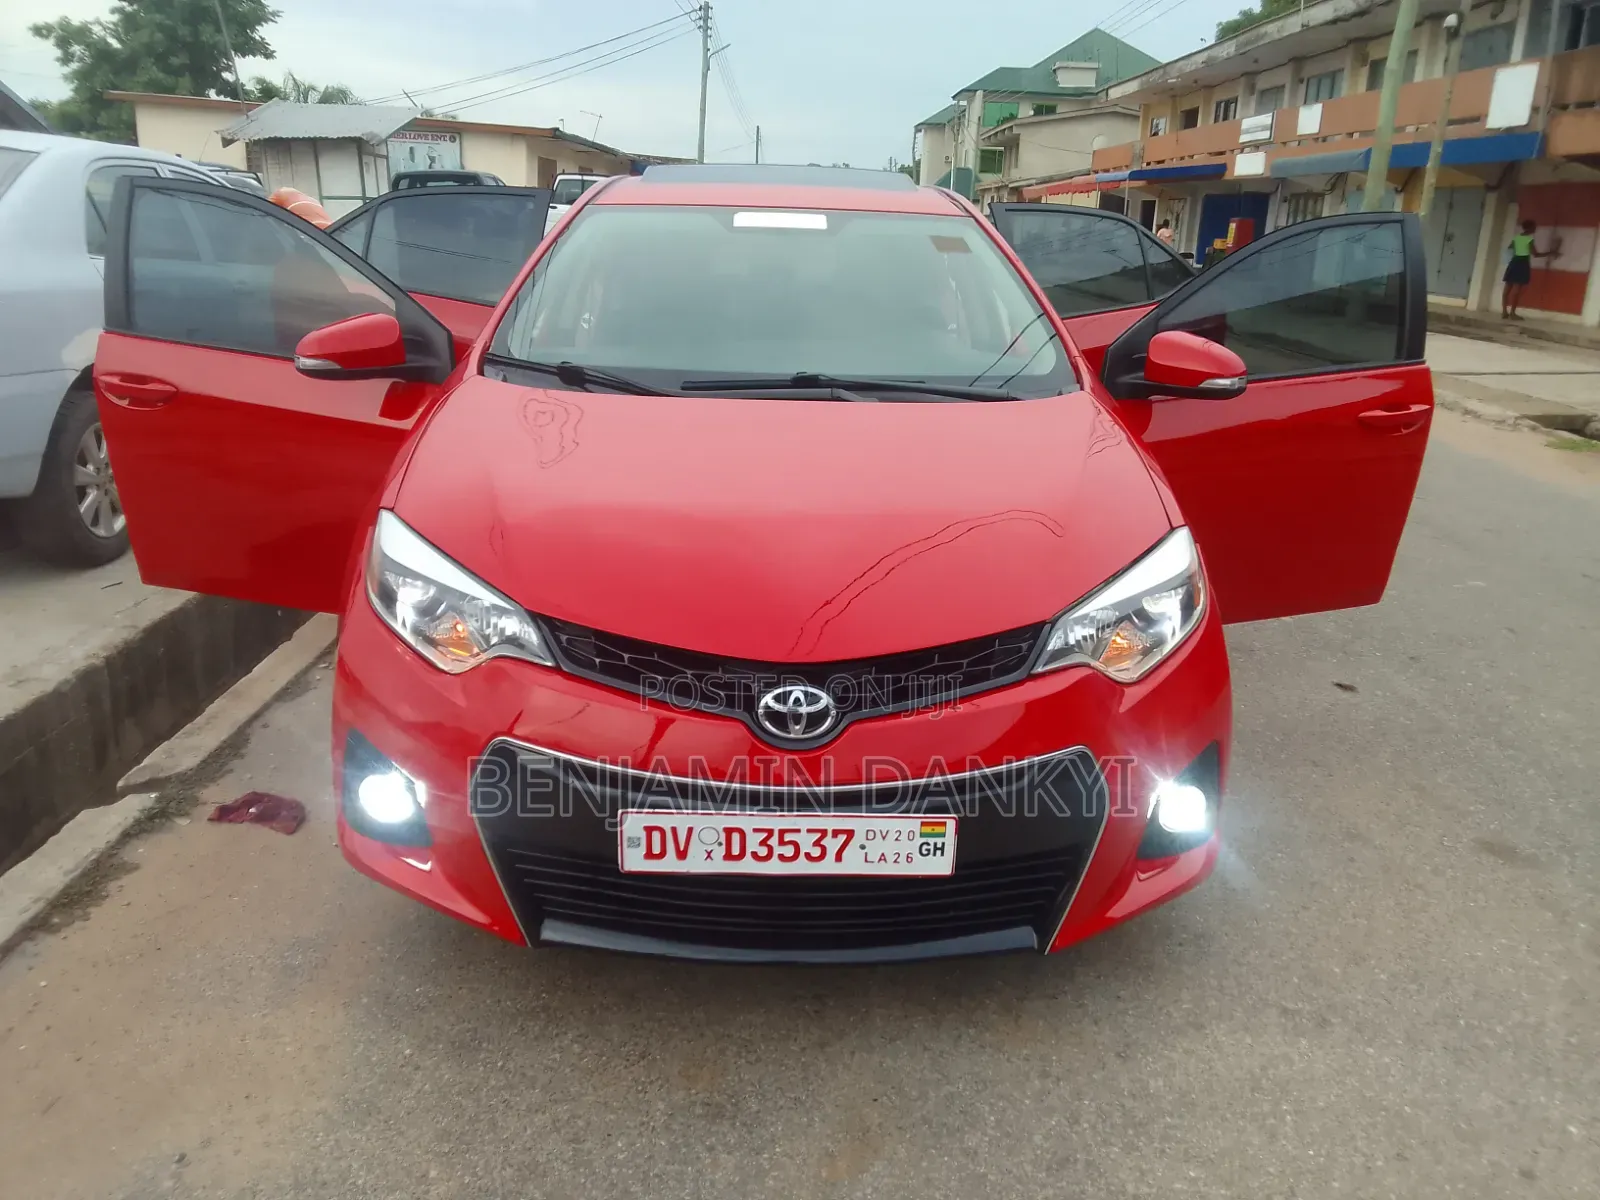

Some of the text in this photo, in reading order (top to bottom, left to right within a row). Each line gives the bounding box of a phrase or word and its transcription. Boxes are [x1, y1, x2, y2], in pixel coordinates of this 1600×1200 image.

[643, 825, 856, 863] DV D3537
[918, 841, 946, 858] GH
